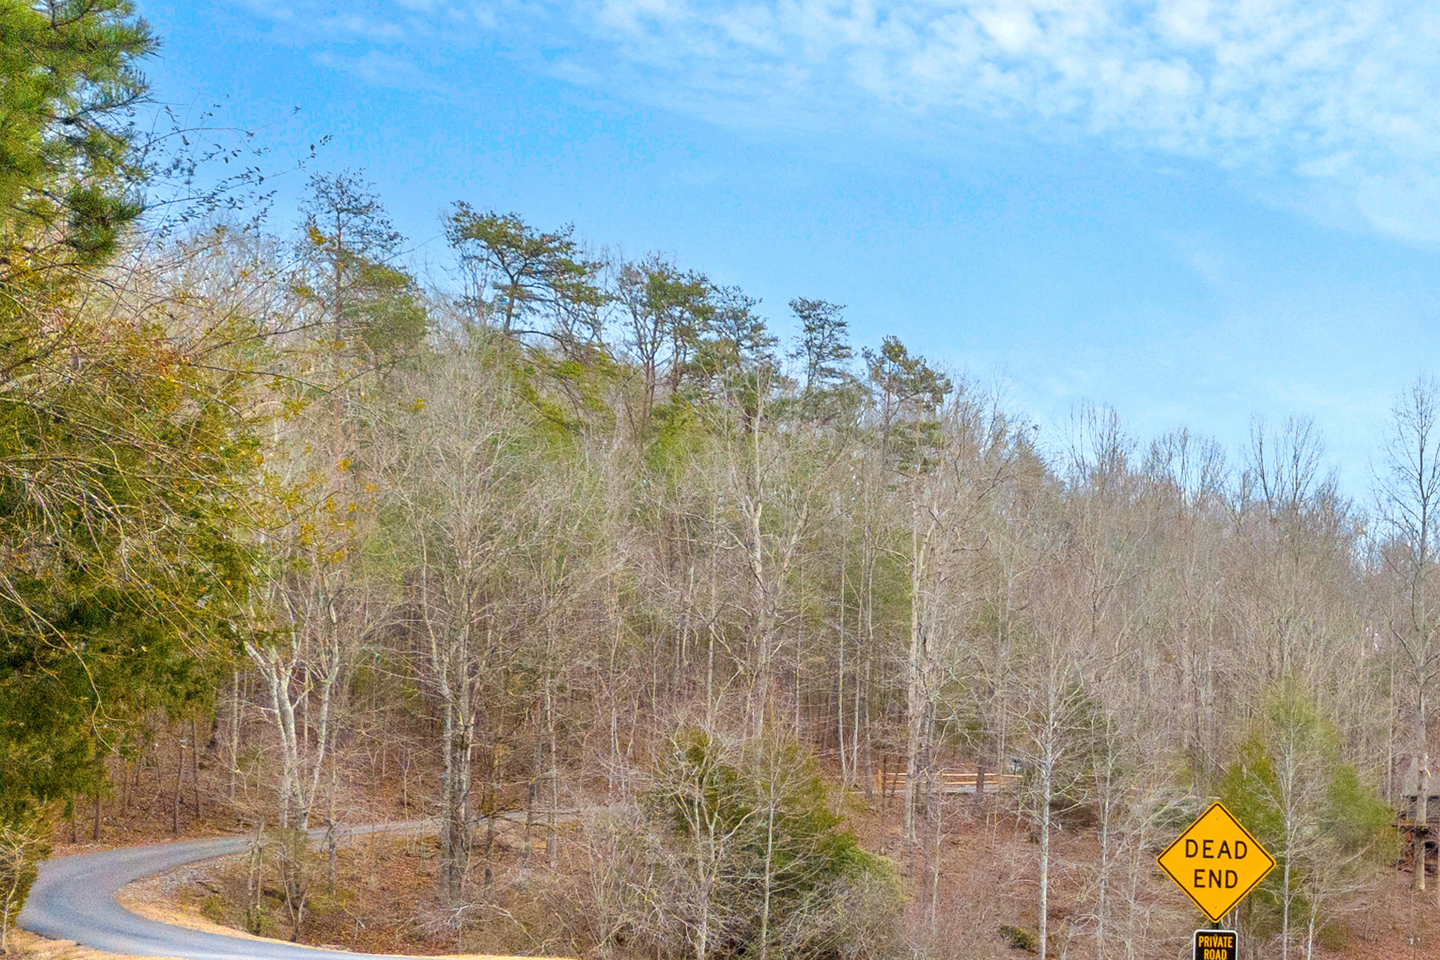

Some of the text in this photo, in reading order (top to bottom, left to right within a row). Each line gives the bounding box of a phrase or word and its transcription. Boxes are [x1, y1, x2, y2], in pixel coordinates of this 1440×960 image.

[1185, 839, 1248, 859] DEAD
[1194, 869, 1238, 889] END
[1198, 936, 1233, 949] PRIVATE
[1204, 948, 1227, 960] ROAD
